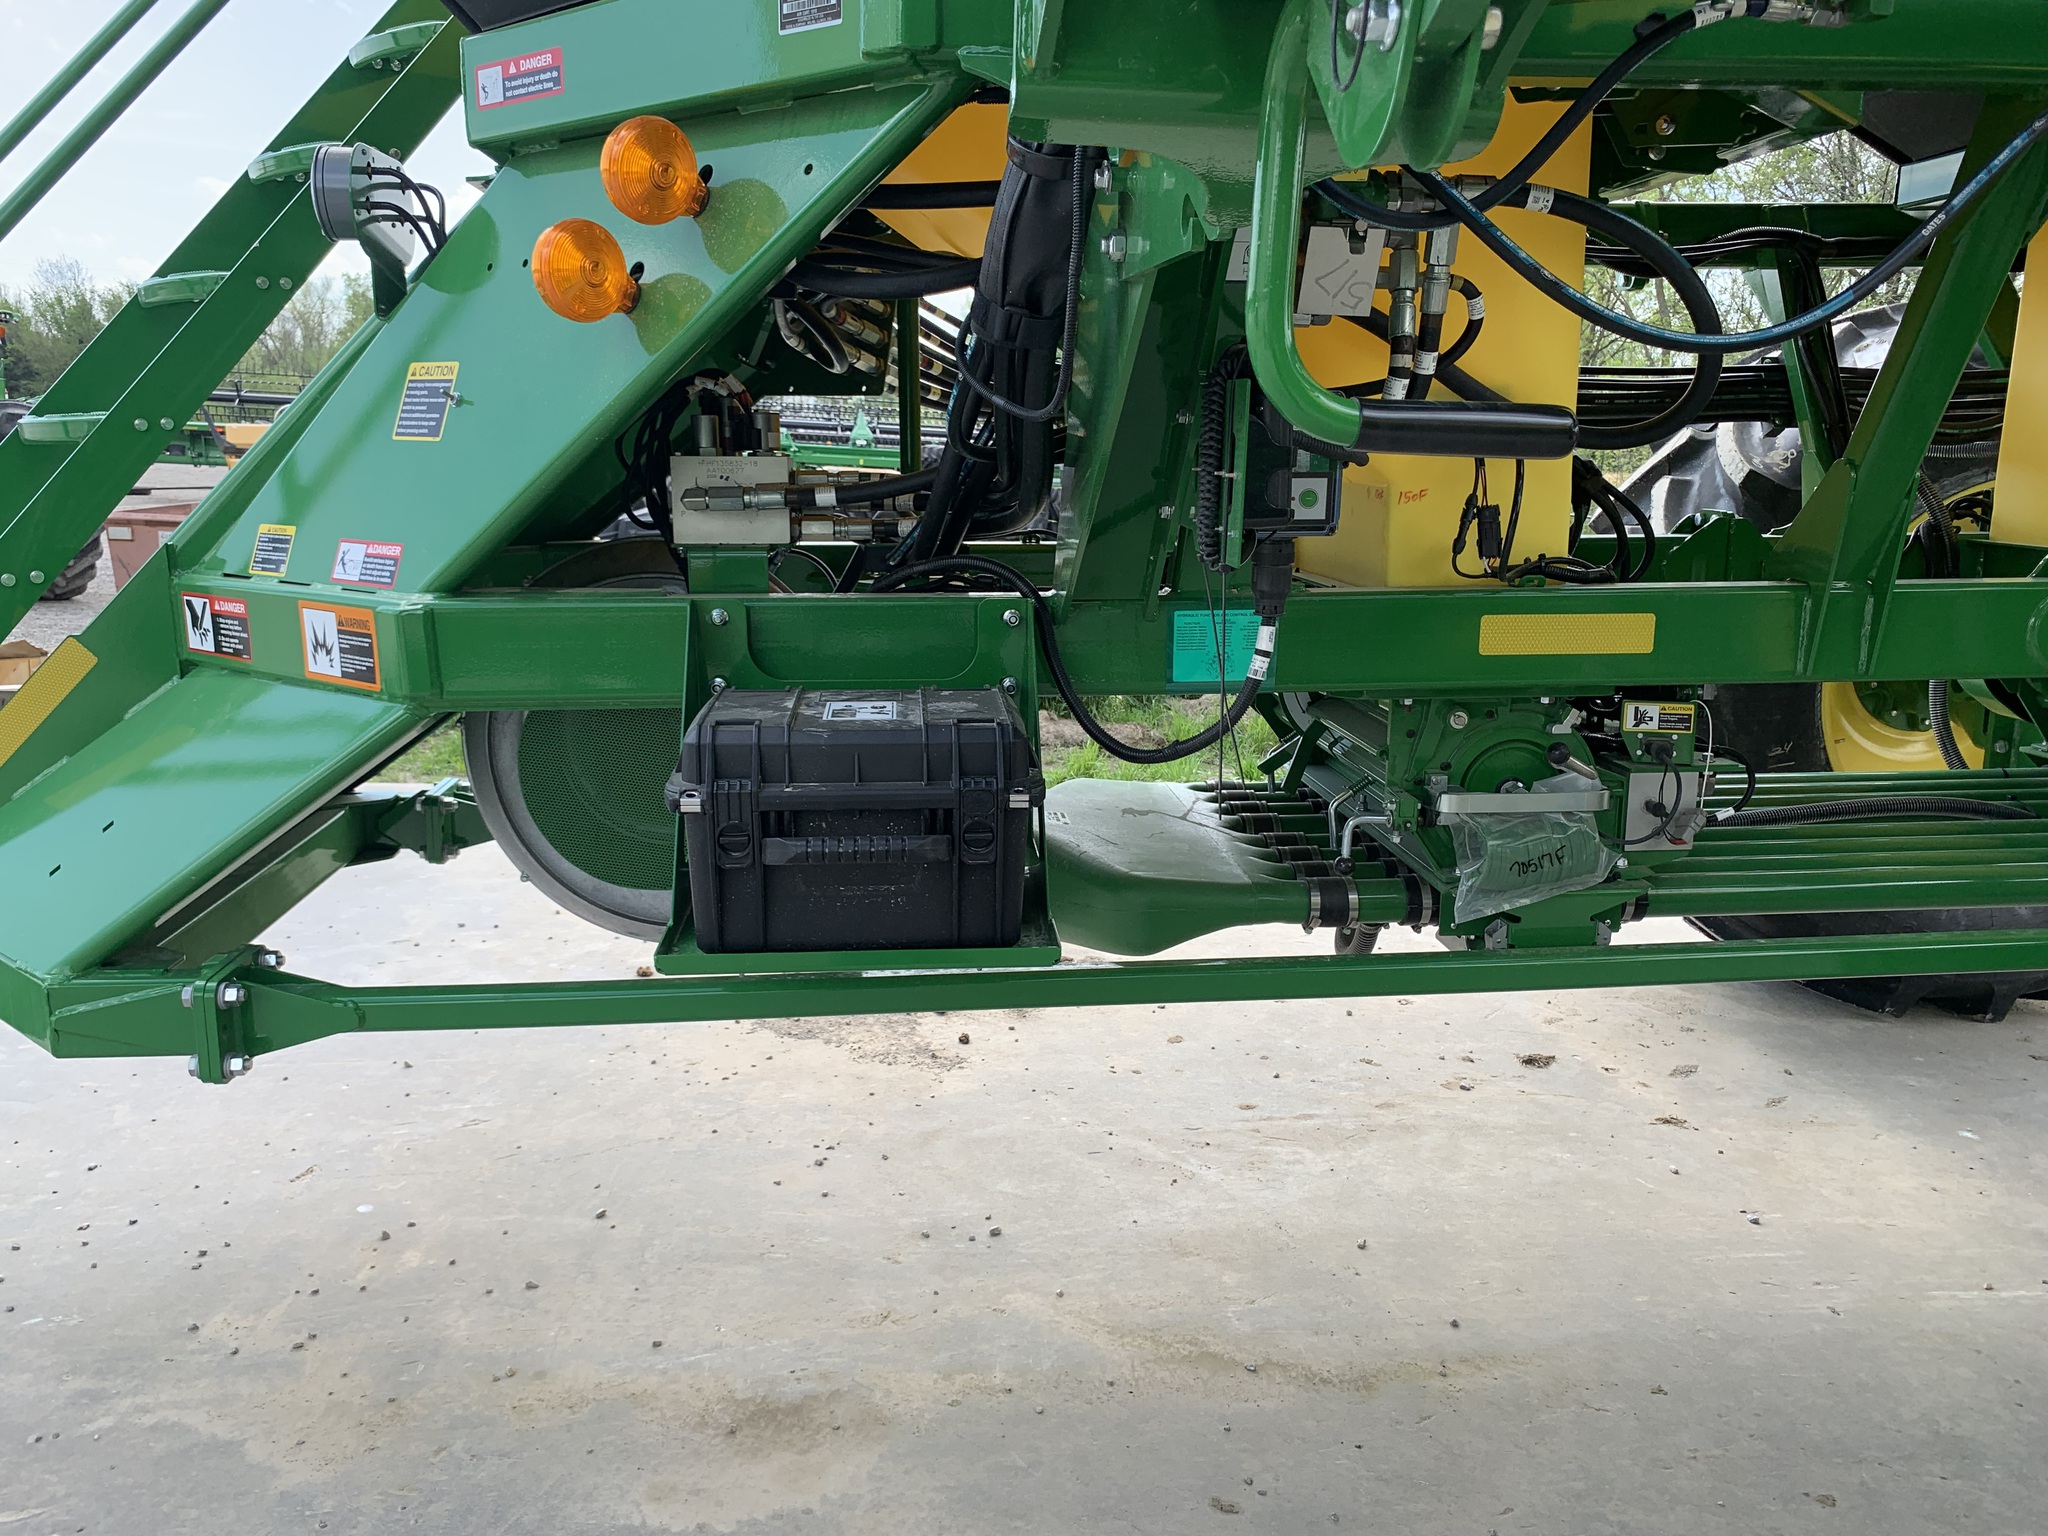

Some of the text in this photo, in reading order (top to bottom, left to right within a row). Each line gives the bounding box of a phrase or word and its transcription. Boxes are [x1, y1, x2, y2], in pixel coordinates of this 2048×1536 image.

[520, 54, 552, 71] DANGER
[1922, 211, 1946, 236] GATES
[419, 366, 455, 376] CAUTION
[373, 544, 401, 556] DANGER
[220, 601, 245, 614] DANGER
[344, 617, 370, 631] WARNING
